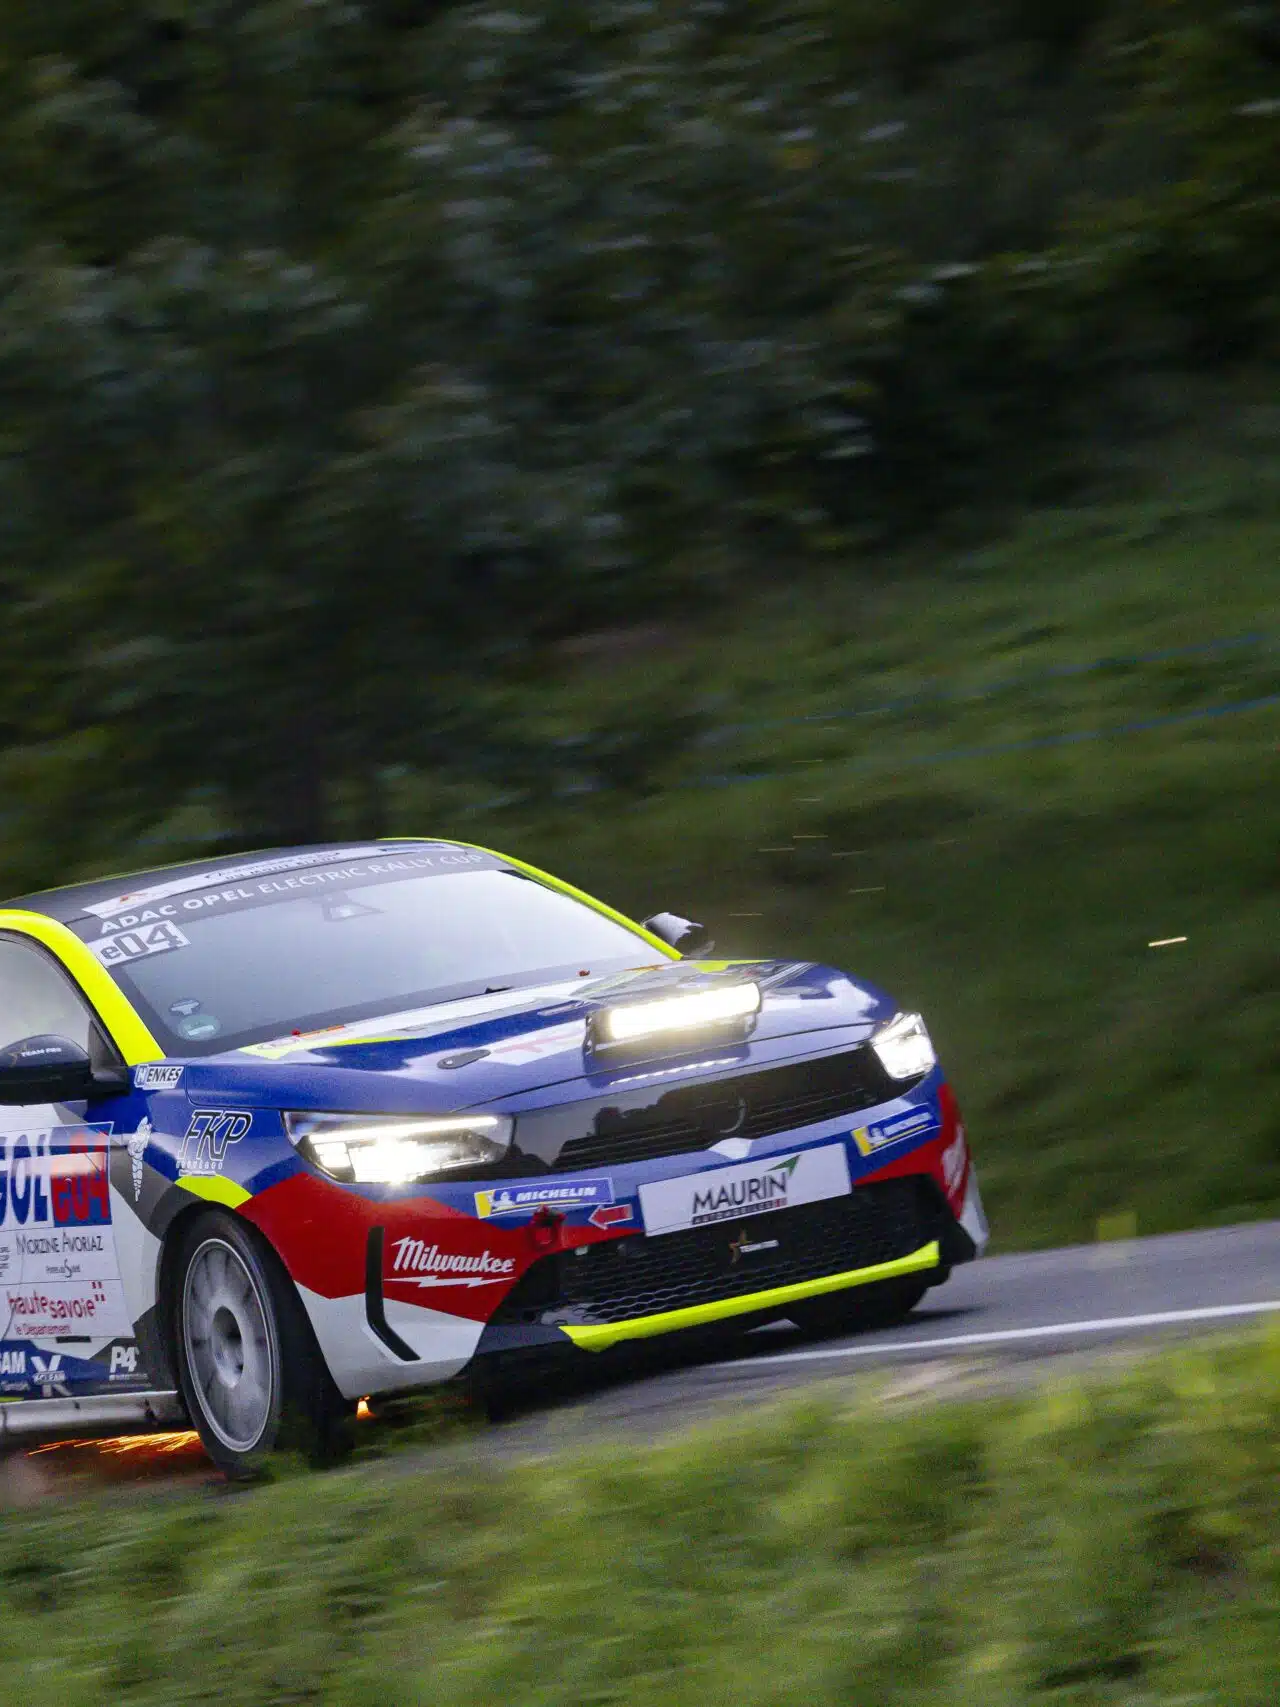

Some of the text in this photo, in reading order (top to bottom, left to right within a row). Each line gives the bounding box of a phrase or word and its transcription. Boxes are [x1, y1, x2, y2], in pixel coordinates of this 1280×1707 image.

[100, 904, 177, 934] ADAC
[182, 887, 255, 910] OPEL
[258, 867, 367, 894] ELECTRIC
[368, 856, 436, 876] RALLY
[439, 853, 483, 866] CUP
[100, 922, 183, 960] e04
[178, 1109, 253, 1163] FKP
[516, 1186, 597, 1202] MICHELIN
[692, 1172, 787, 1214] MAURIN
[16, 1229, 104, 1255] MORZINE AVORIAZ
[391, 1235, 514, 1273] Milwaukee
[7, 1290, 96, 1319] haute savoie
